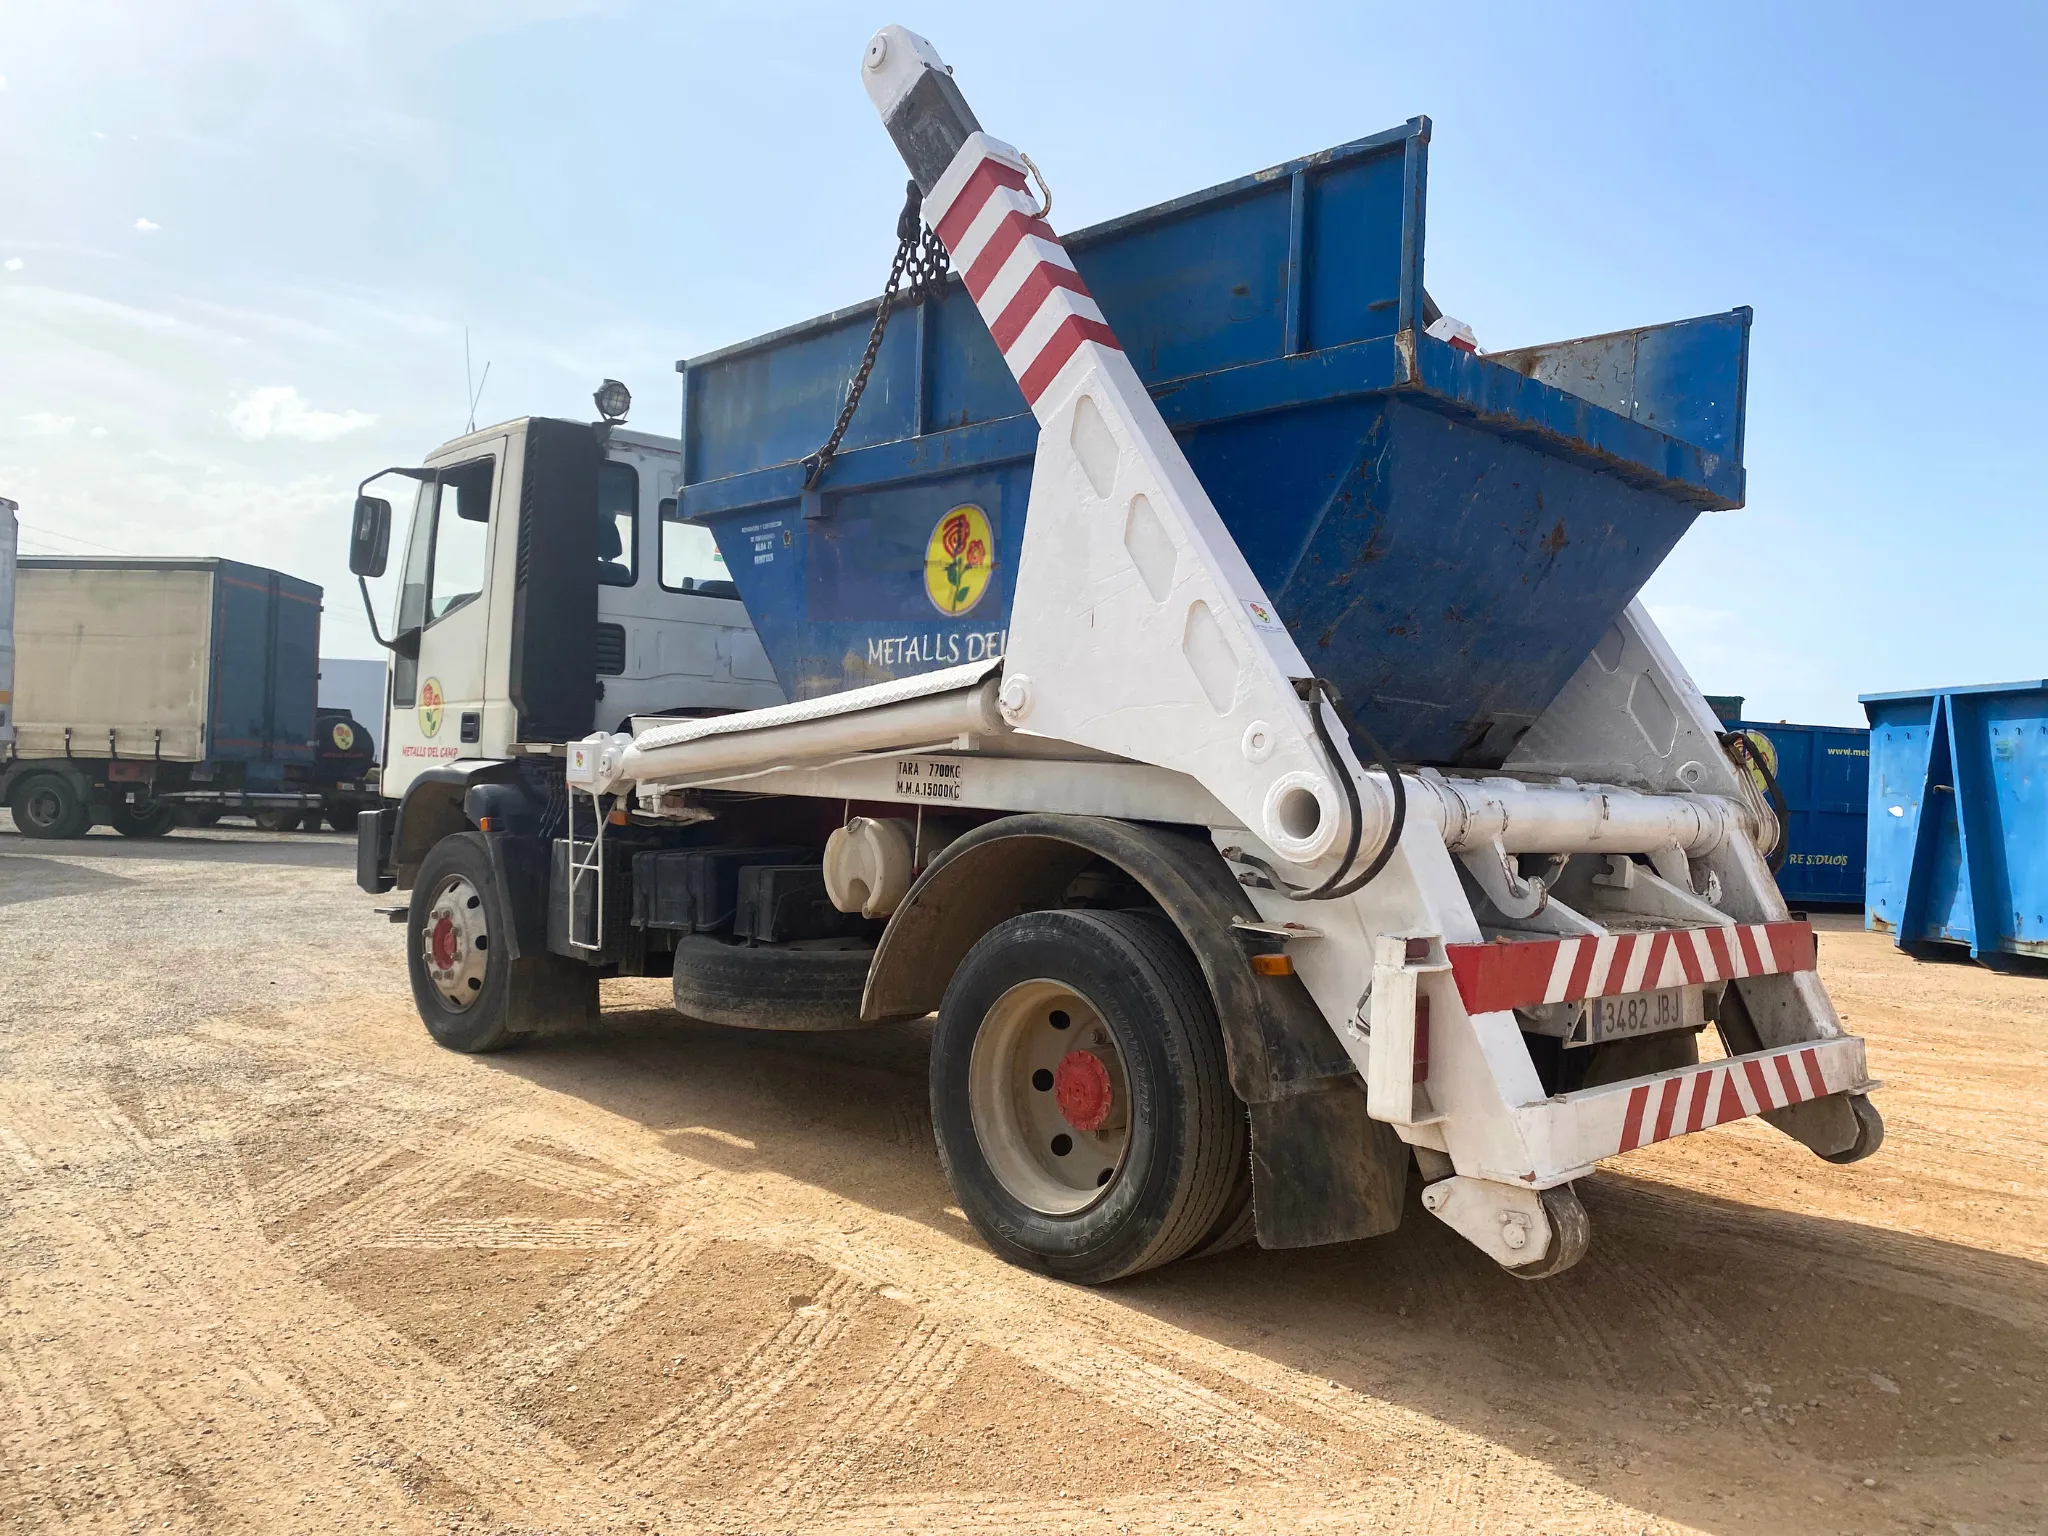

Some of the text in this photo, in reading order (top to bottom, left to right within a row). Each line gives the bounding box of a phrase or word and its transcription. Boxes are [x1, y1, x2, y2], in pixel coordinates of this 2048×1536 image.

[867, 633, 960, 666] METALLS
[402, 746, 458, 759] METALLS DEL CAMP
[898, 761, 961, 779] TARA 7700KG
[1605, 992, 1680, 1034] 3482 JBJ
